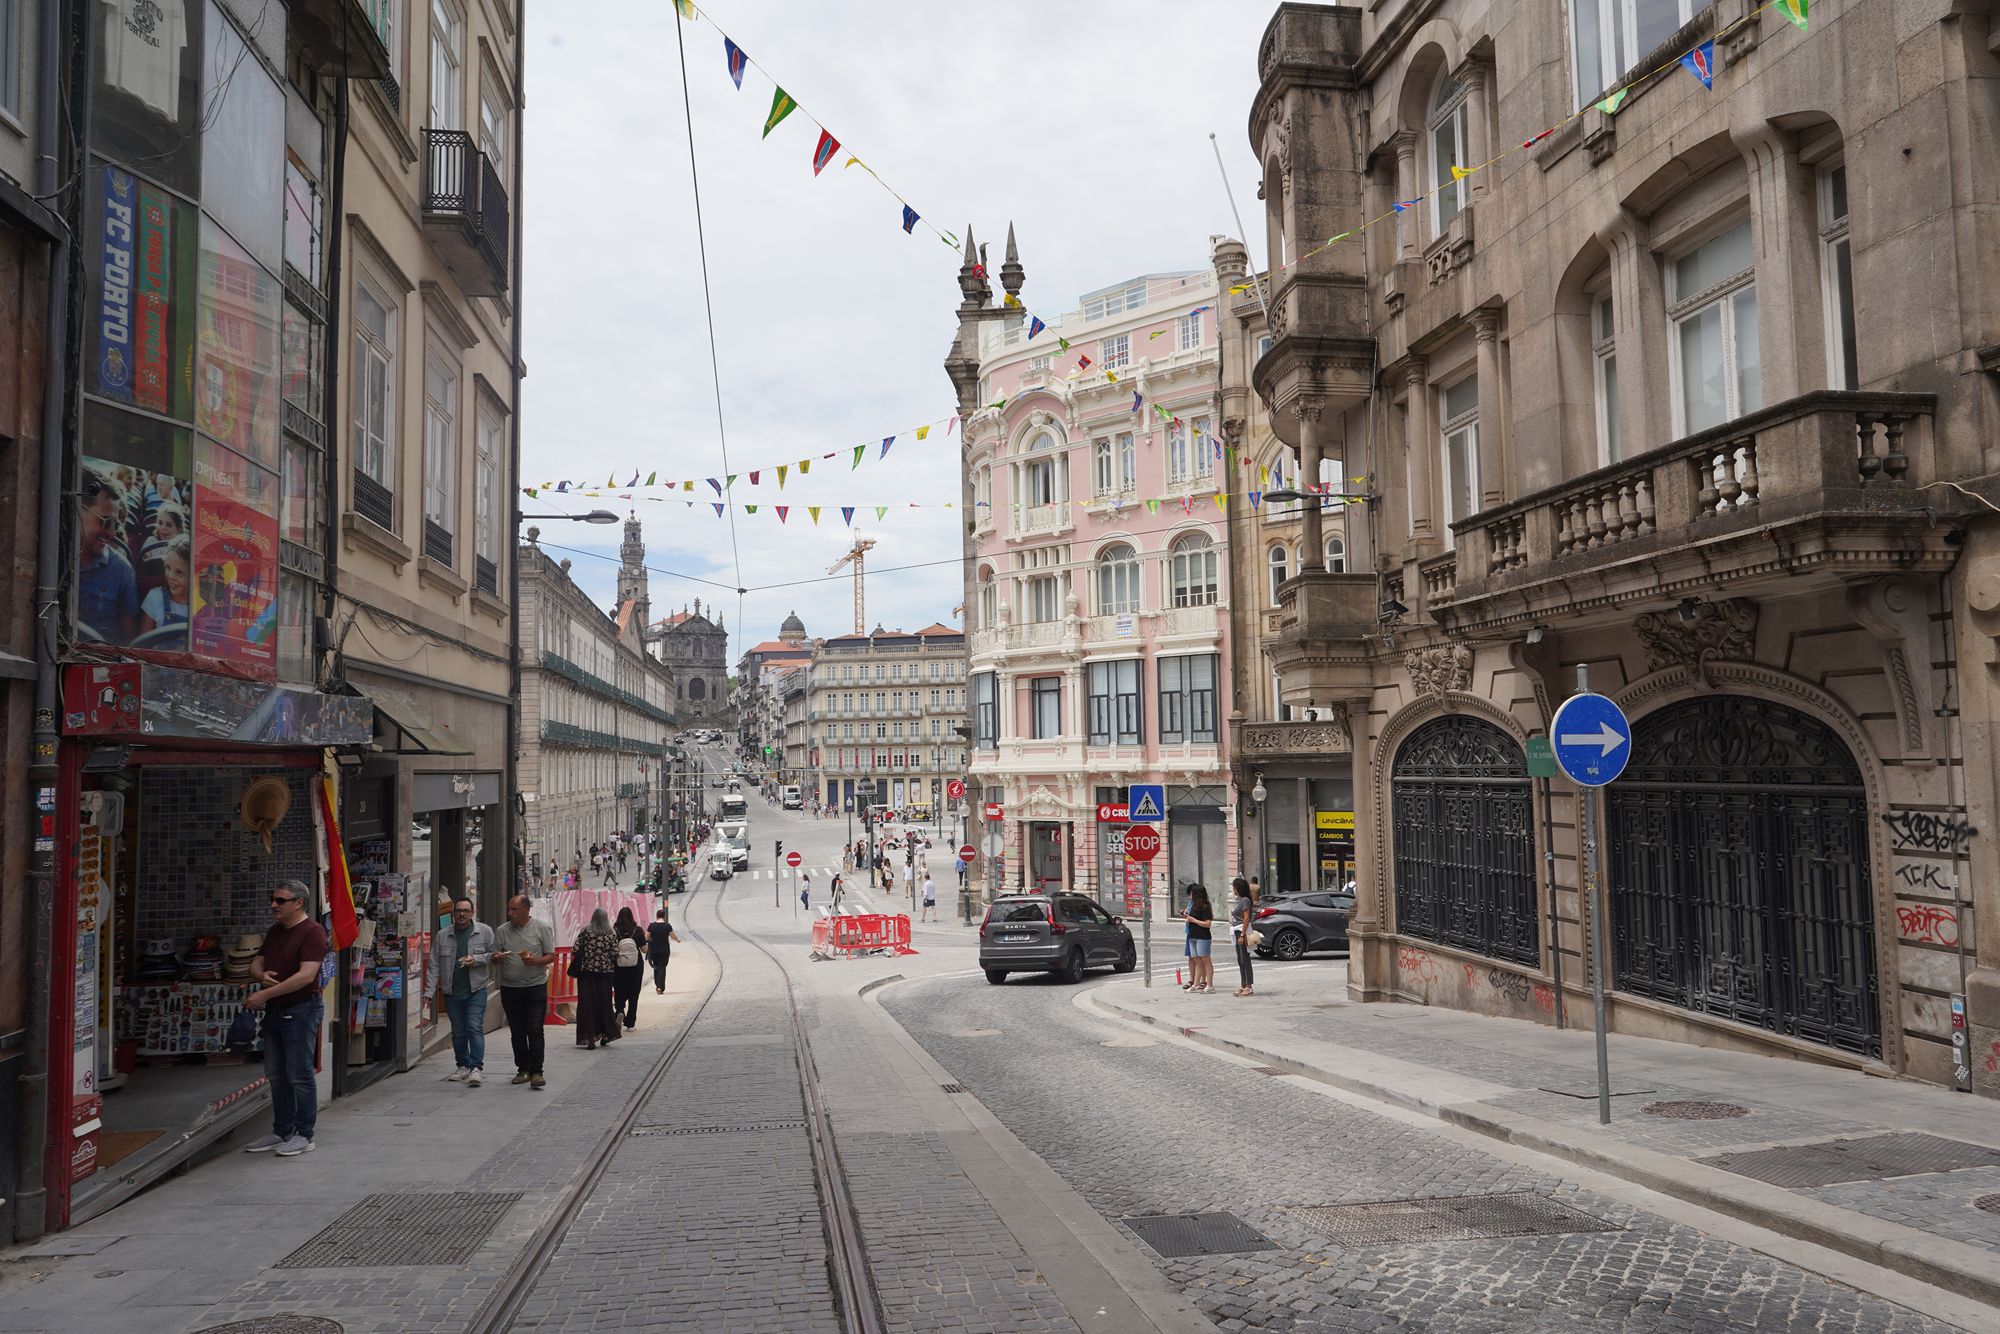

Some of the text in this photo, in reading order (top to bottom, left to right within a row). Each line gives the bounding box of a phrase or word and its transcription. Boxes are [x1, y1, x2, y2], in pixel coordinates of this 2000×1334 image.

[103, 198, 132, 344] FC PORTO
[144, 720, 154, 732] 24
[1112, 809, 1129, 817] CRU
[1106, 844, 1125, 854] SER
[1125, 836, 1160, 850] STOP
